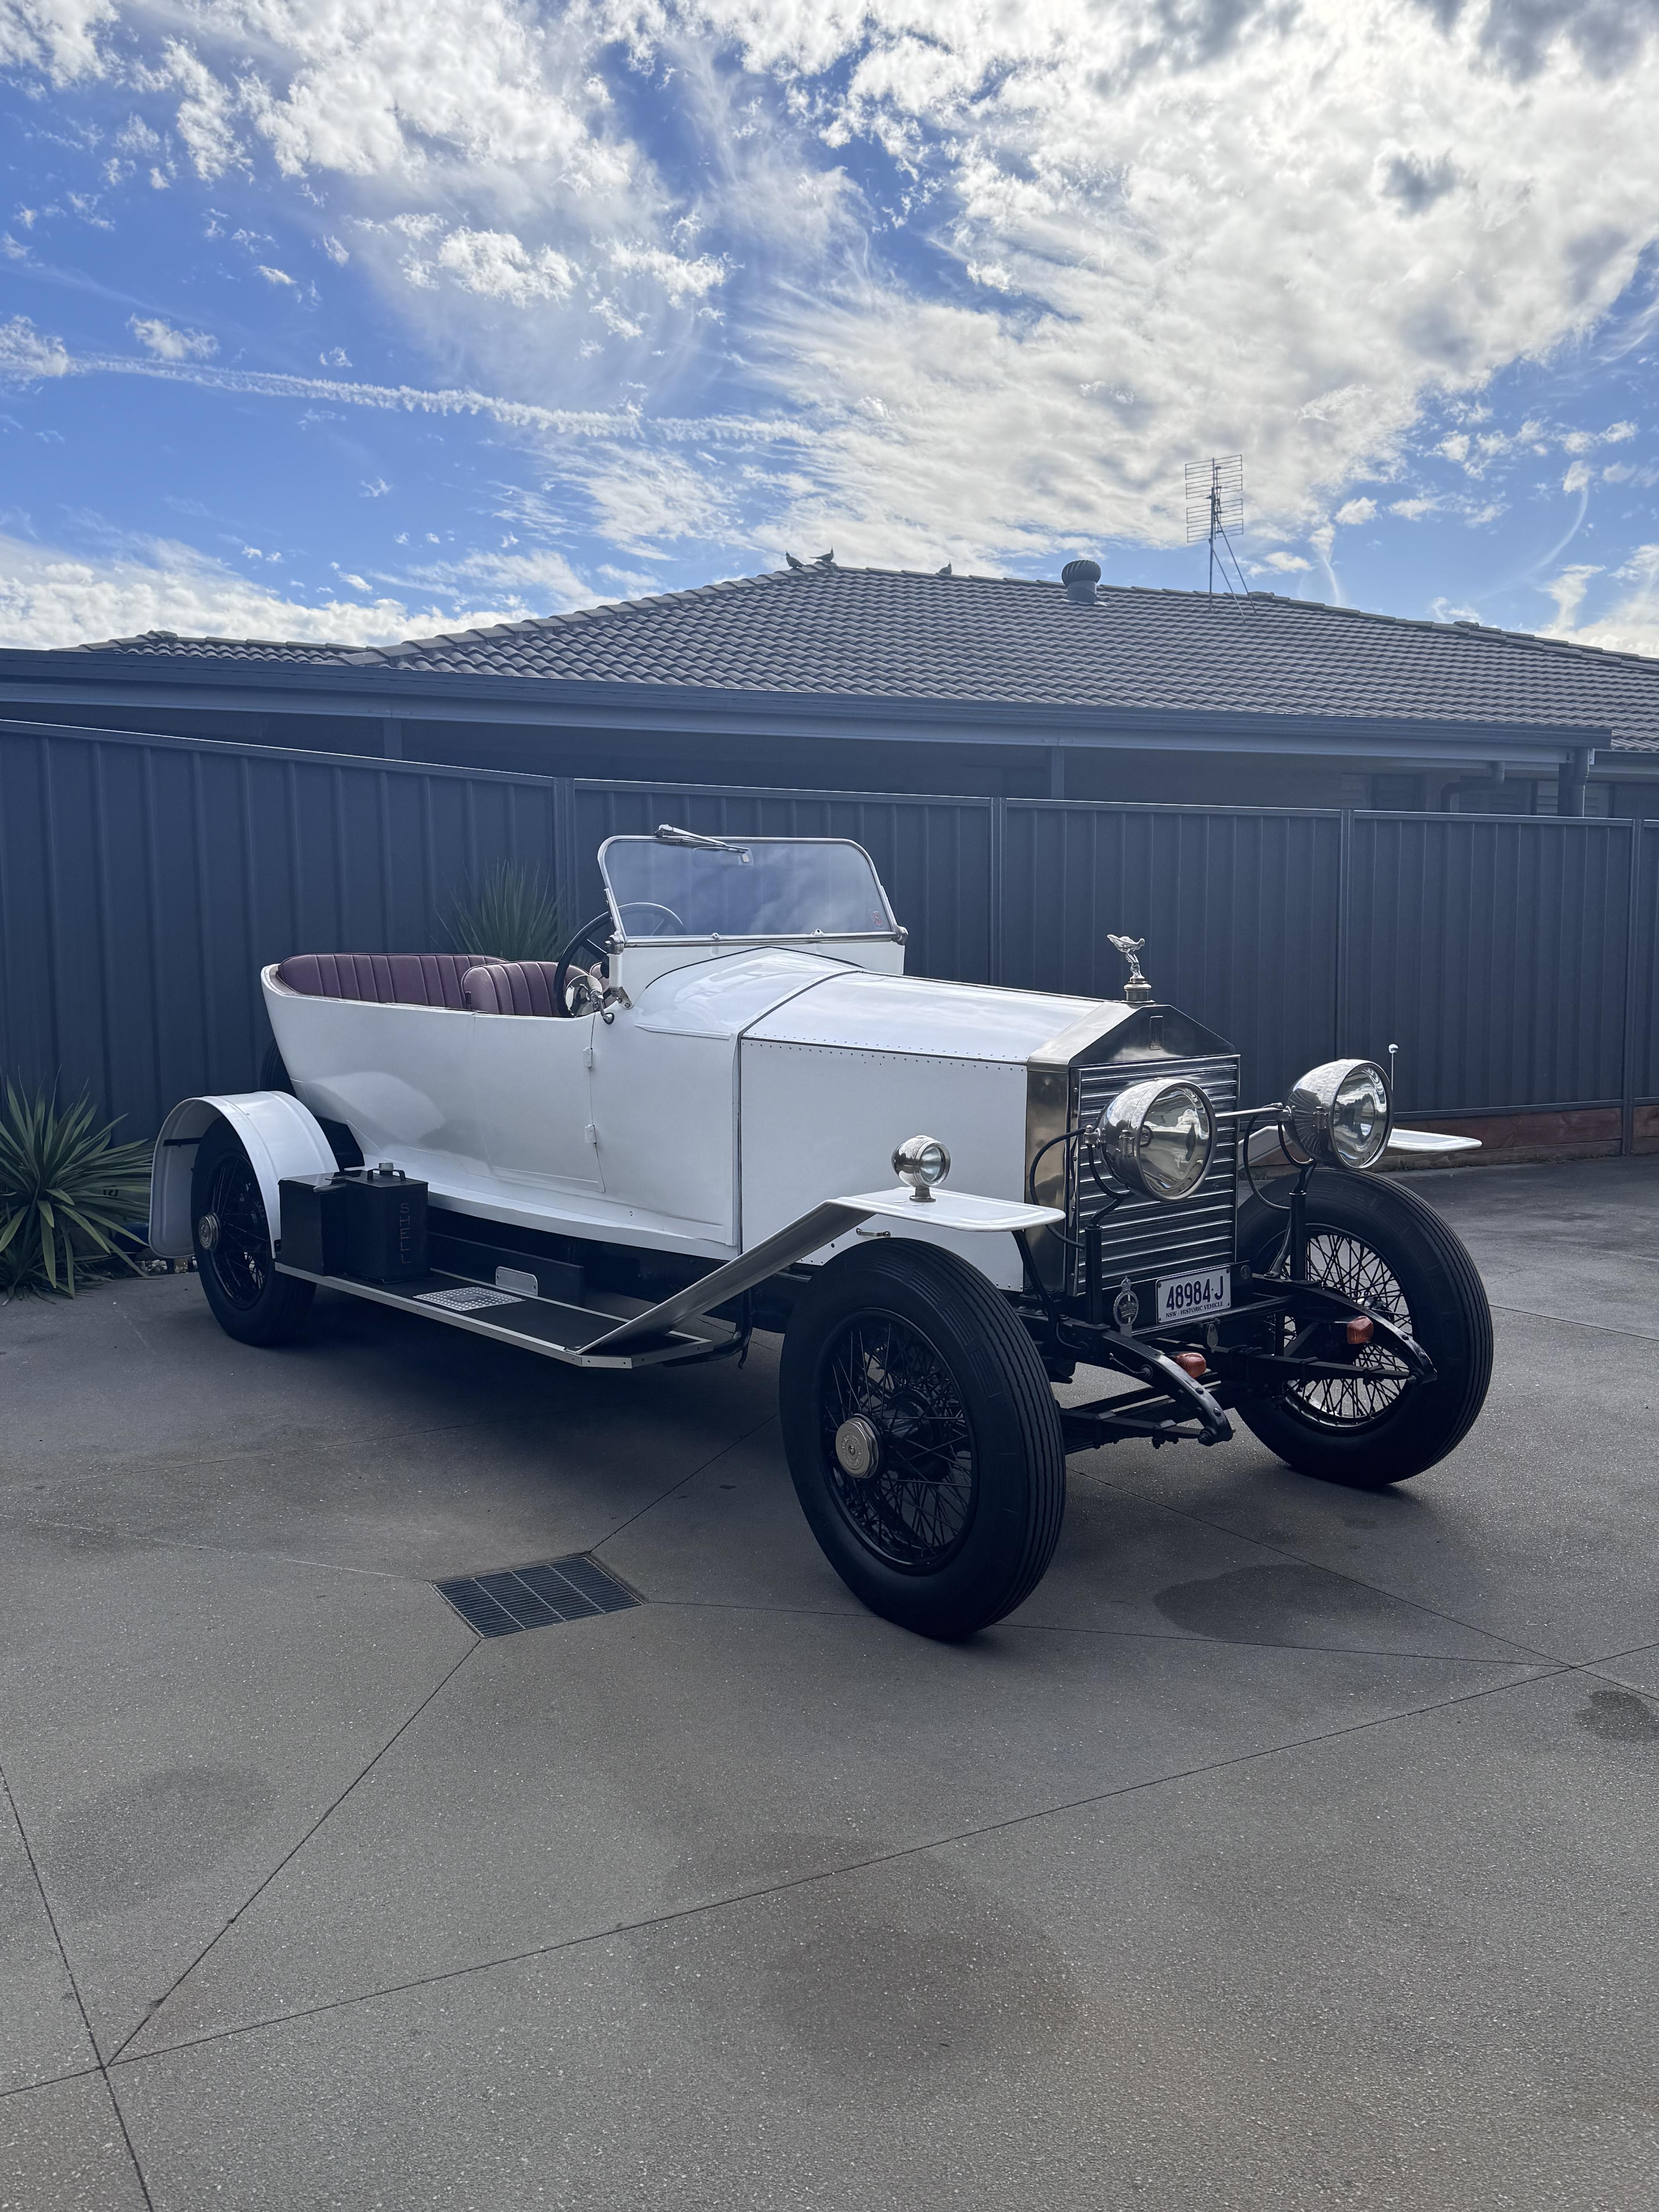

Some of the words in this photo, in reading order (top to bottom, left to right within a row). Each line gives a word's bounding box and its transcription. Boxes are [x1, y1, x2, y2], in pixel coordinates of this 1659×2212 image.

[400, 1202, 411, 1264] SHELL
[1181, 1305, 1203, 1315] HISTORIC
[1204, 1301, 1223, 1309] VEHICLE
